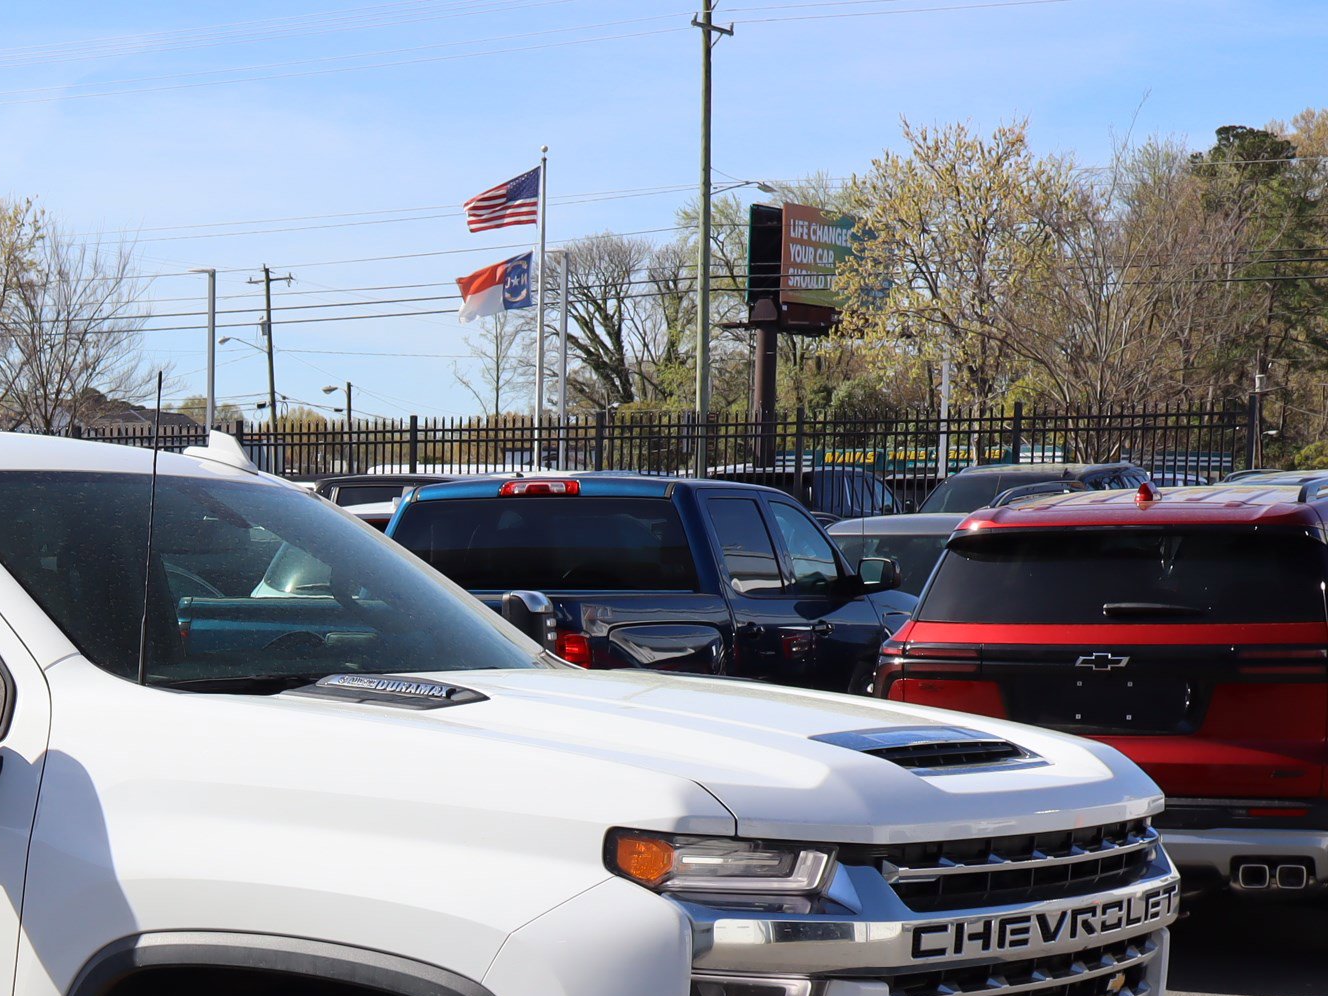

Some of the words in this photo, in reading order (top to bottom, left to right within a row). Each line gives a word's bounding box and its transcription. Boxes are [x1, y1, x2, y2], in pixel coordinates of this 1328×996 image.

[790, 219, 808, 239] LIFE
[790, 243, 814, 264] YOUR
[788, 268, 825, 289] SHOULD
[375, 679, 447, 697] DURAMAX
[911, 884, 1177, 960] CHEVROLET
